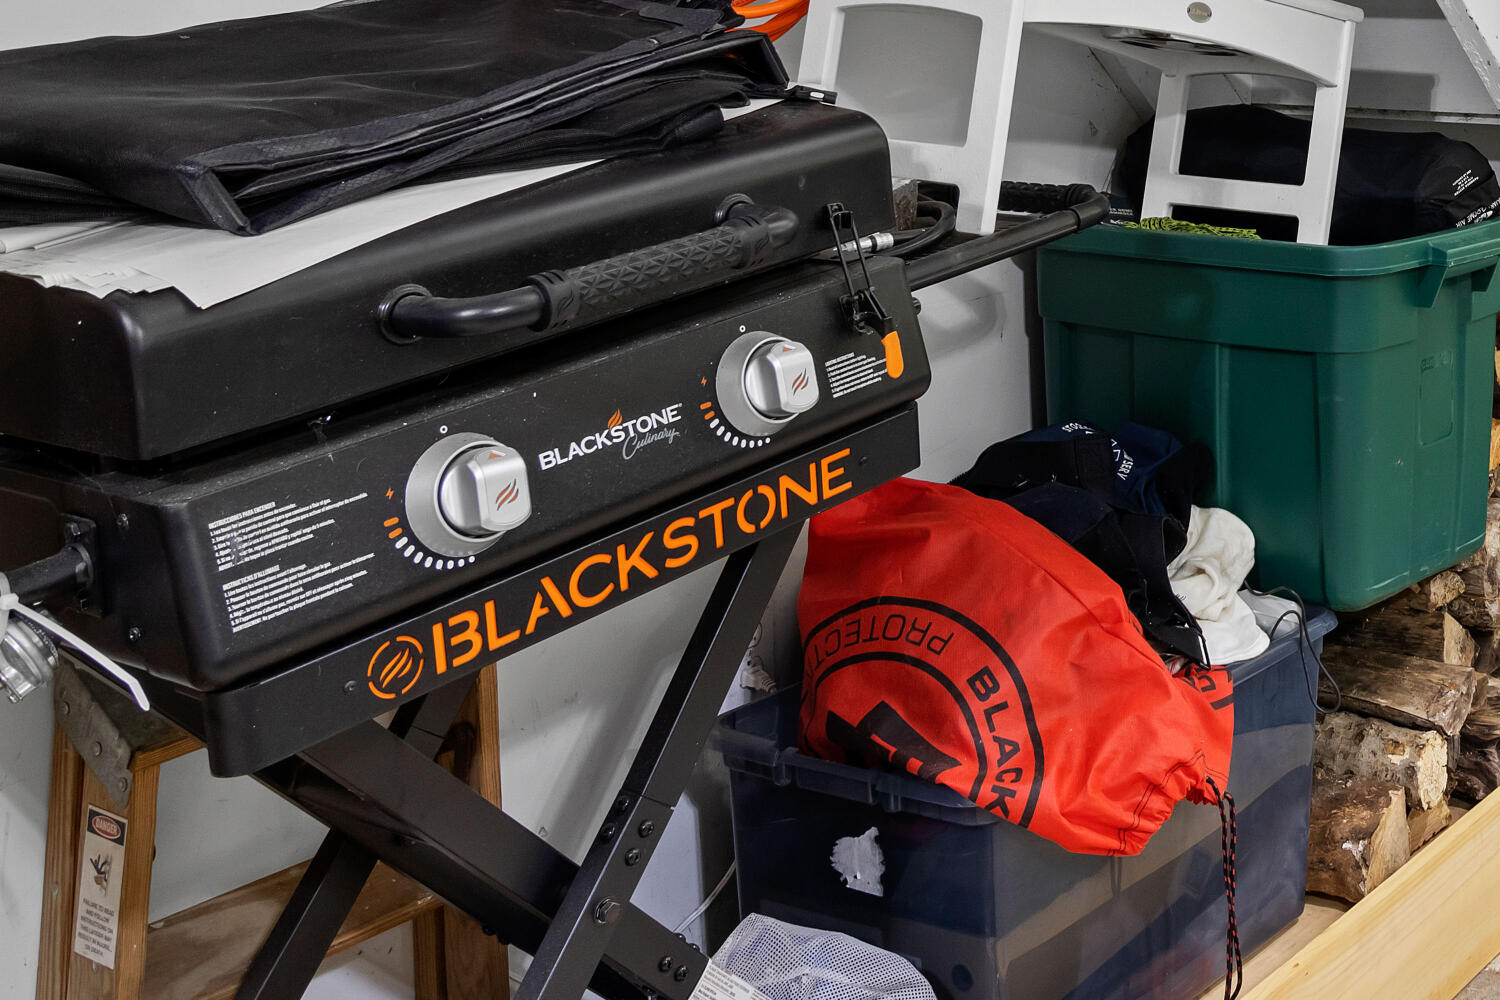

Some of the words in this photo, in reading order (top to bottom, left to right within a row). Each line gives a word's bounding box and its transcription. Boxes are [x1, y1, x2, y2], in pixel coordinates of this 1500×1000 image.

[538, 404, 682, 470] BLACKSTONE
[622, 427, 680, 460] Culinary
[431, 447, 853, 676] BLACKSTONE
